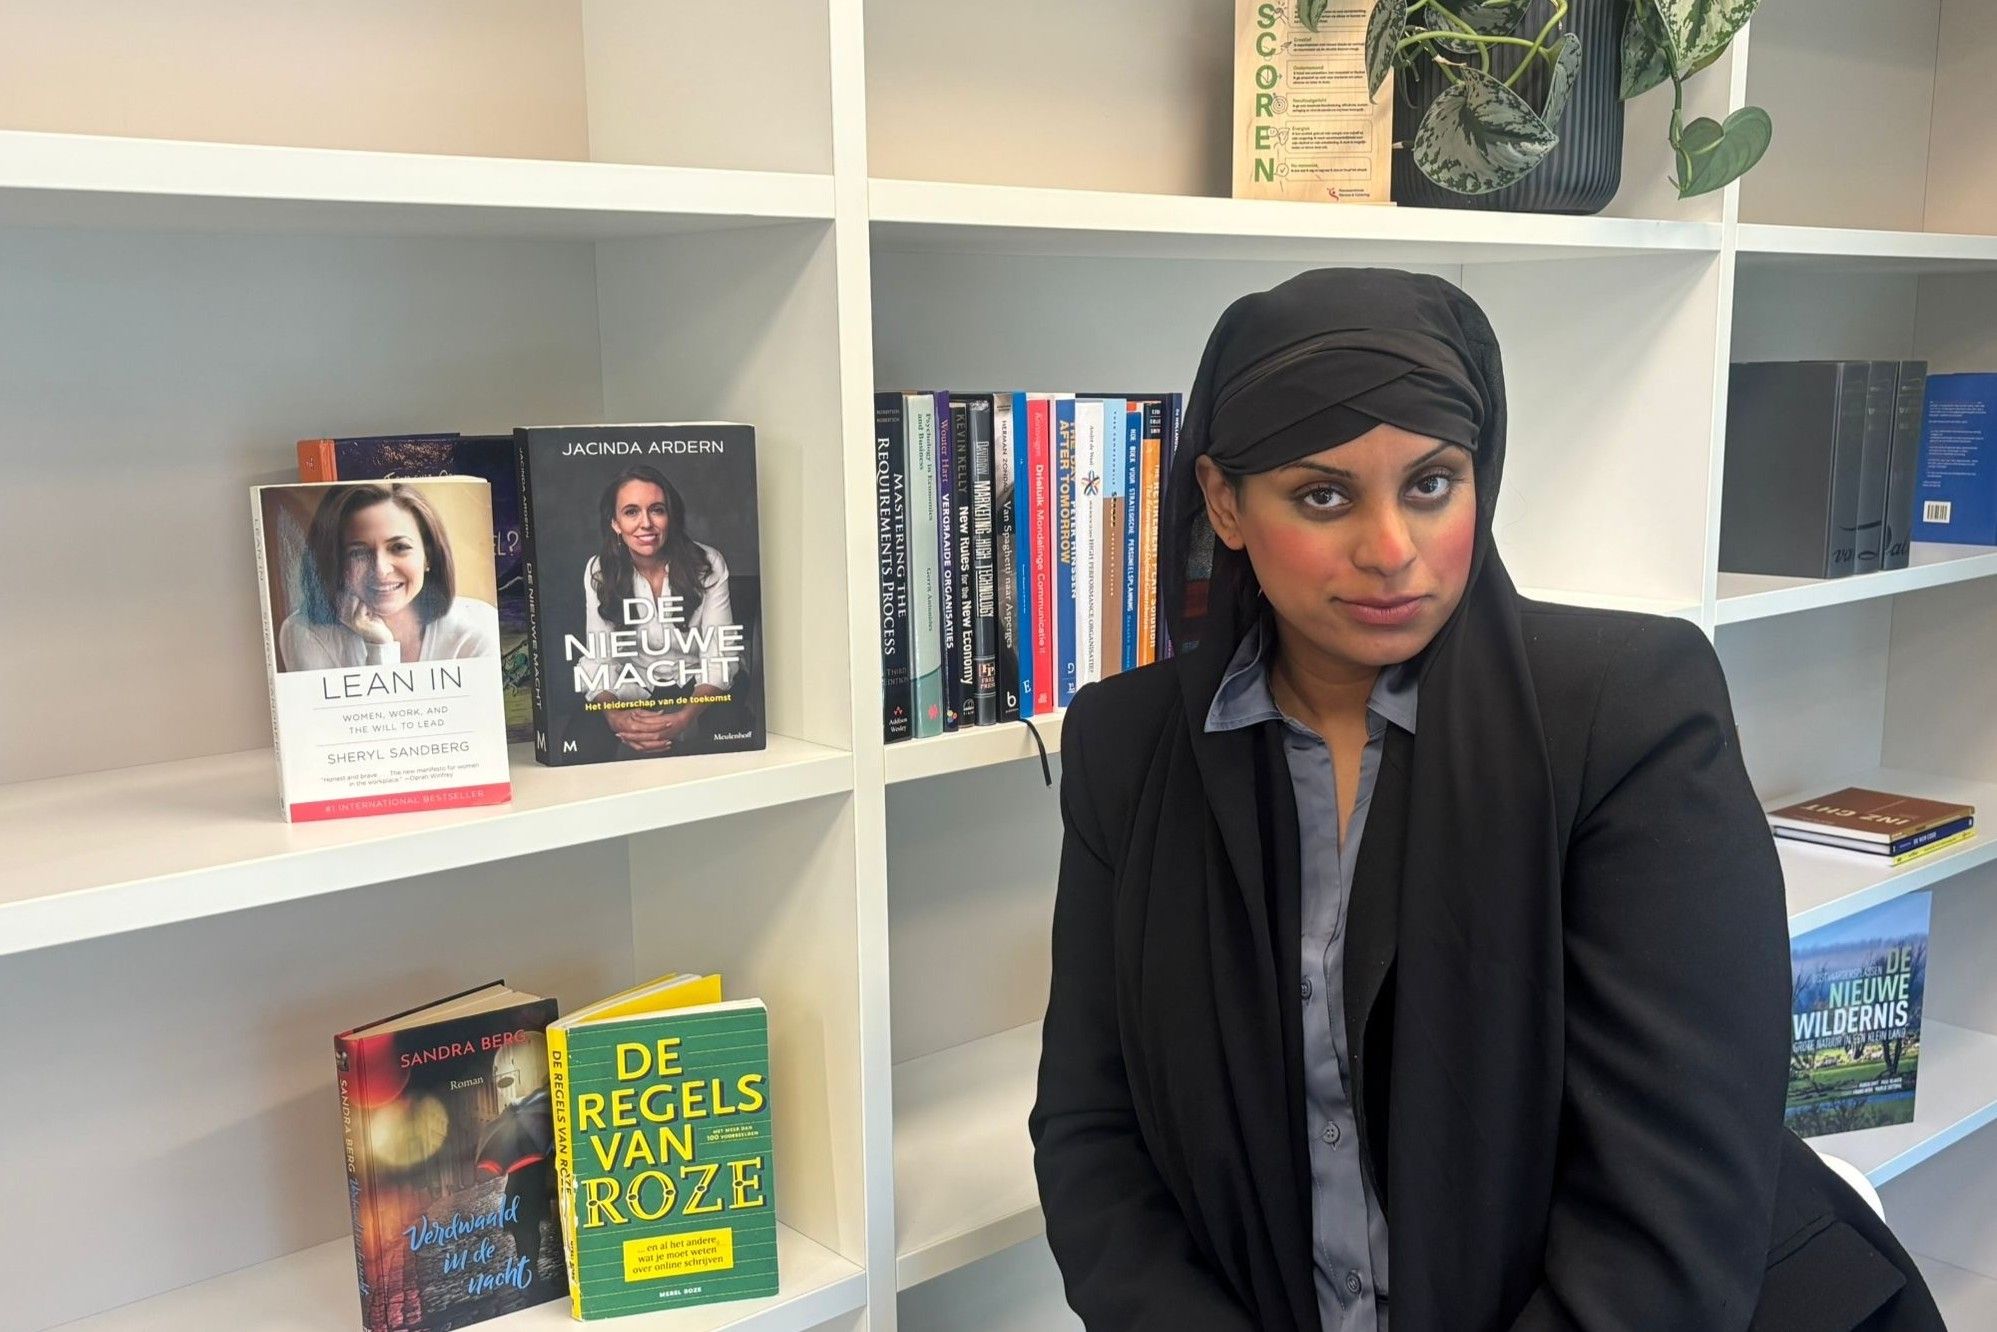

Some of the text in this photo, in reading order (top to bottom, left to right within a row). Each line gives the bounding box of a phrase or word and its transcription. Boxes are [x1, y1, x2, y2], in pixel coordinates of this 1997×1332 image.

[1254, 3, 1278, 183] SCOREN
[562, 440, 724, 456] JACINDA ARDERN
[940, 419, 948, 457] Wouter
[956, 413, 968, 493] KEVIN KELLY
[1060, 419, 1071, 564] AFTER TOMORROW
[959, 506, 969, 533] New
[876, 437, 896, 655] REQUIREMENTS PROCESS
[894, 473, 907, 617] MASTERING THE
[961, 536, 970, 571] Rules
[974, 480, 994, 618] MARKETING HIGH TECHNOLOGY
[1035, 464, 1045, 646] Drieluik Mondelinge Communicatie
[961, 587, 969, 599] the
[1002, 500, 1014, 649] Van Spaghetti naar Asperges
[623, 596, 685, 625] DE
[944, 571, 954, 649] ORGANISATIES
[962, 600, 972, 627] New
[526, 563, 542, 711] DE NIEUWE MACHT
[564, 625, 745, 661] NIEUWE
[573, 656, 740, 693] MACHT
[961, 630, 973, 685] Economy
[322, 665, 463, 700] LEAN IN
[342, 705, 449, 722] WOMEN, WORK, AND
[585, 694, 732, 711] Het leiderschap van de toekomst
[349, 719, 445, 734] THE WILL TO LEAD
[713, 731, 752, 741] Meulenhoff
[327, 741, 470, 765] SHERYL SANDBERG
[338, 798, 419, 811] INTERNATIONAL
[422, 789, 485, 803] BESTSELLER
[1886, 946, 1912, 974] DE
[1829, 973, 1911, 1009] NIEUWE
[1792, 1000, 1909, 1041] WILDERNIS
[400, 1029, 528, 1068] SANDRA BERG
[552, 1050, 563, 1068] DE
[616, 1037, 683, 1081] DE
[450, 1075, 484, 1090] Roman
[554, 1072, 566, 1123] REGELS
[578, 1074, 764, 1131] REGELS
[339, 1079, 351, 1134] SANDRA
[345, 1138, 356, 1173] BERG
[558, 1127, 569, 1154] VAN
[590, 1123, 694, 1172] VAN
[581, 1157, 765, 1228] ROZE
[403, 1195, 521, 1250] Verdwaald
[443, 1237, 495, 1274] in de
[638, 1247, 717, 1264] wat je moet weten
[659, 1241, 667, 1250] al
[670, 1240, 684, 1248] het
[468, 1255, 532, 1295] nacht
[632, 1256, 724, 1274] over online schrijven
[659, 1286, 702, 1298] MEREL ROZE
